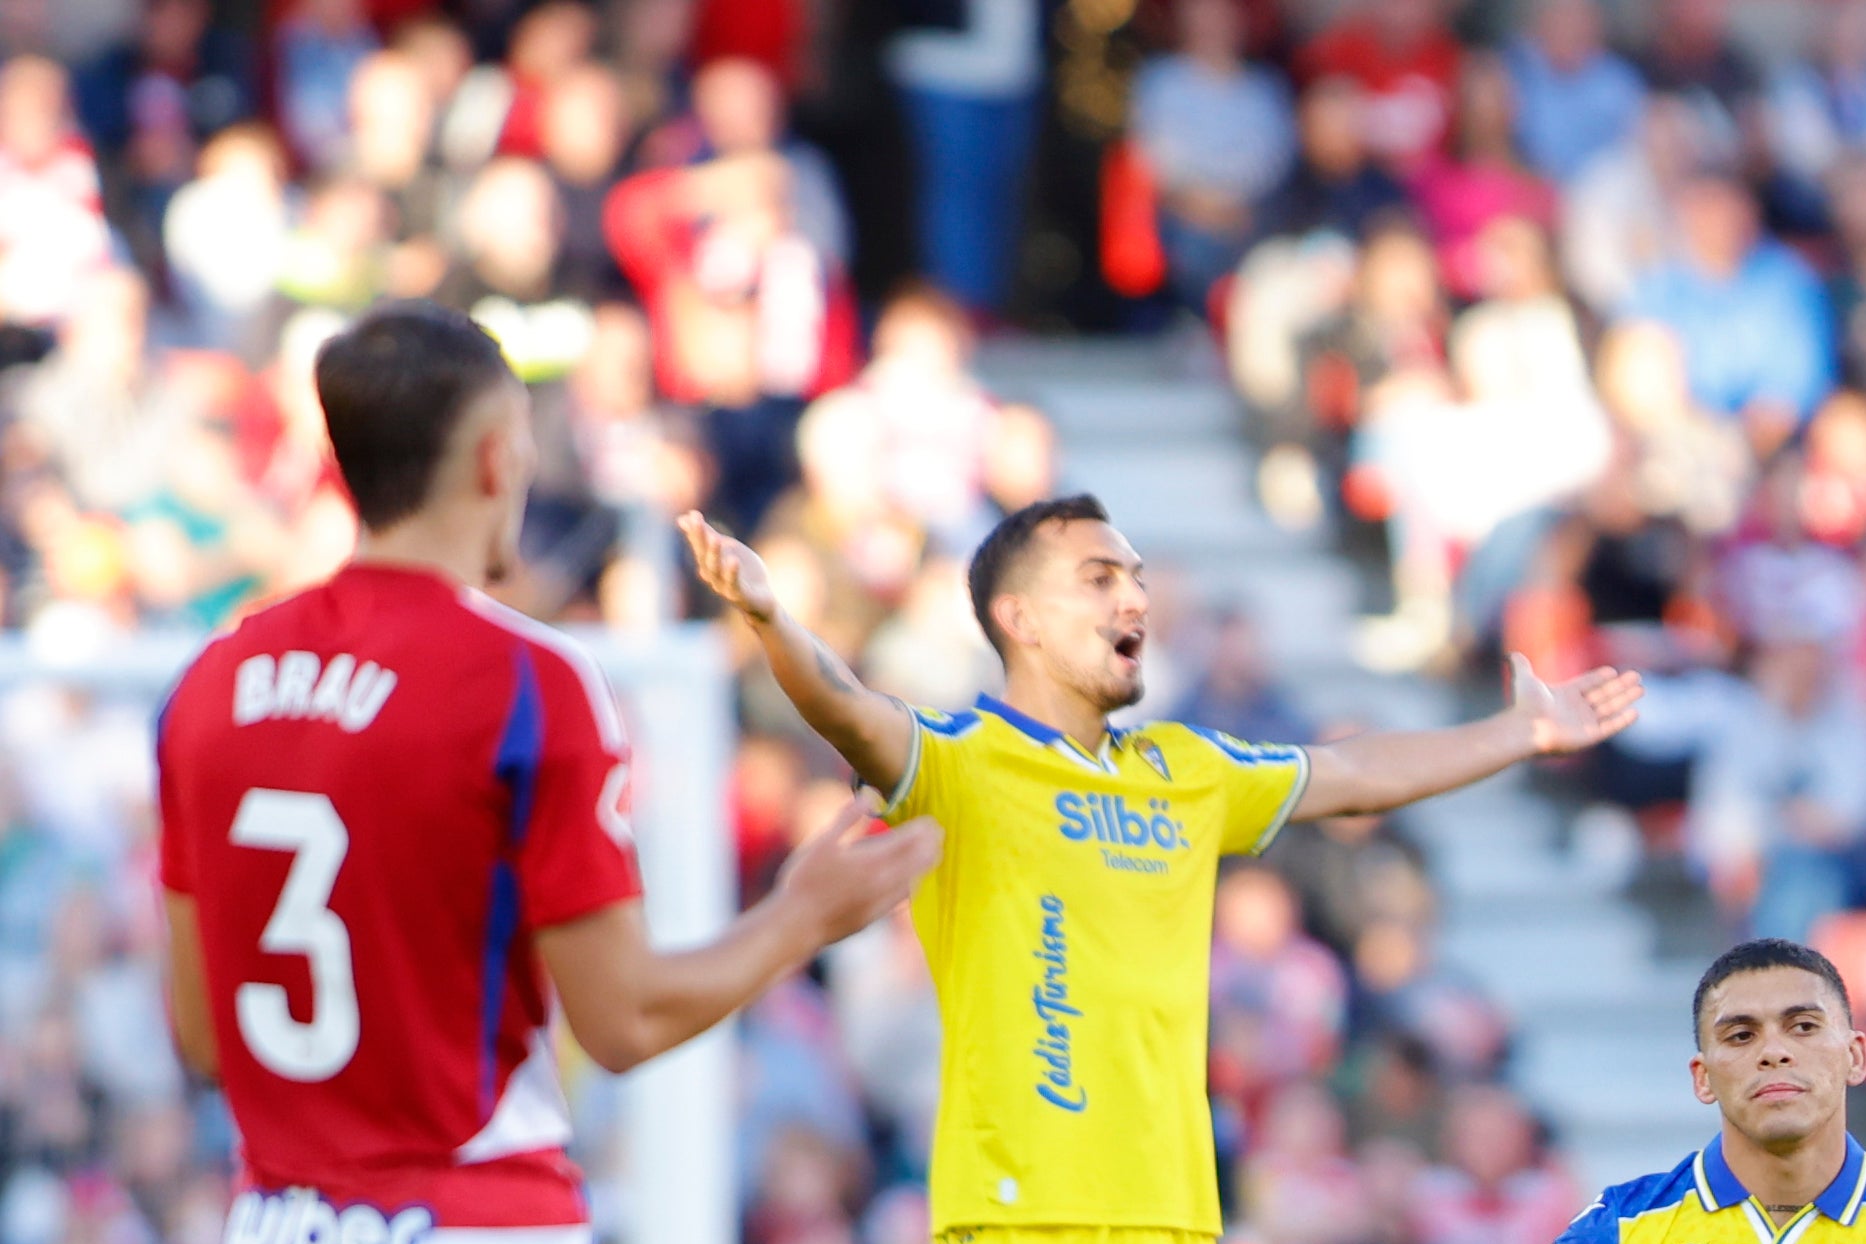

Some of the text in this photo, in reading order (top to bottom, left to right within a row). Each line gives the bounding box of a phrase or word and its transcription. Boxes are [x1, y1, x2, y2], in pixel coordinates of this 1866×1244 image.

[232, 650, 397, 733] BRAU
[1100, 849, 1168, 874] Telecom
[227, 787, 361, 1083] 3
